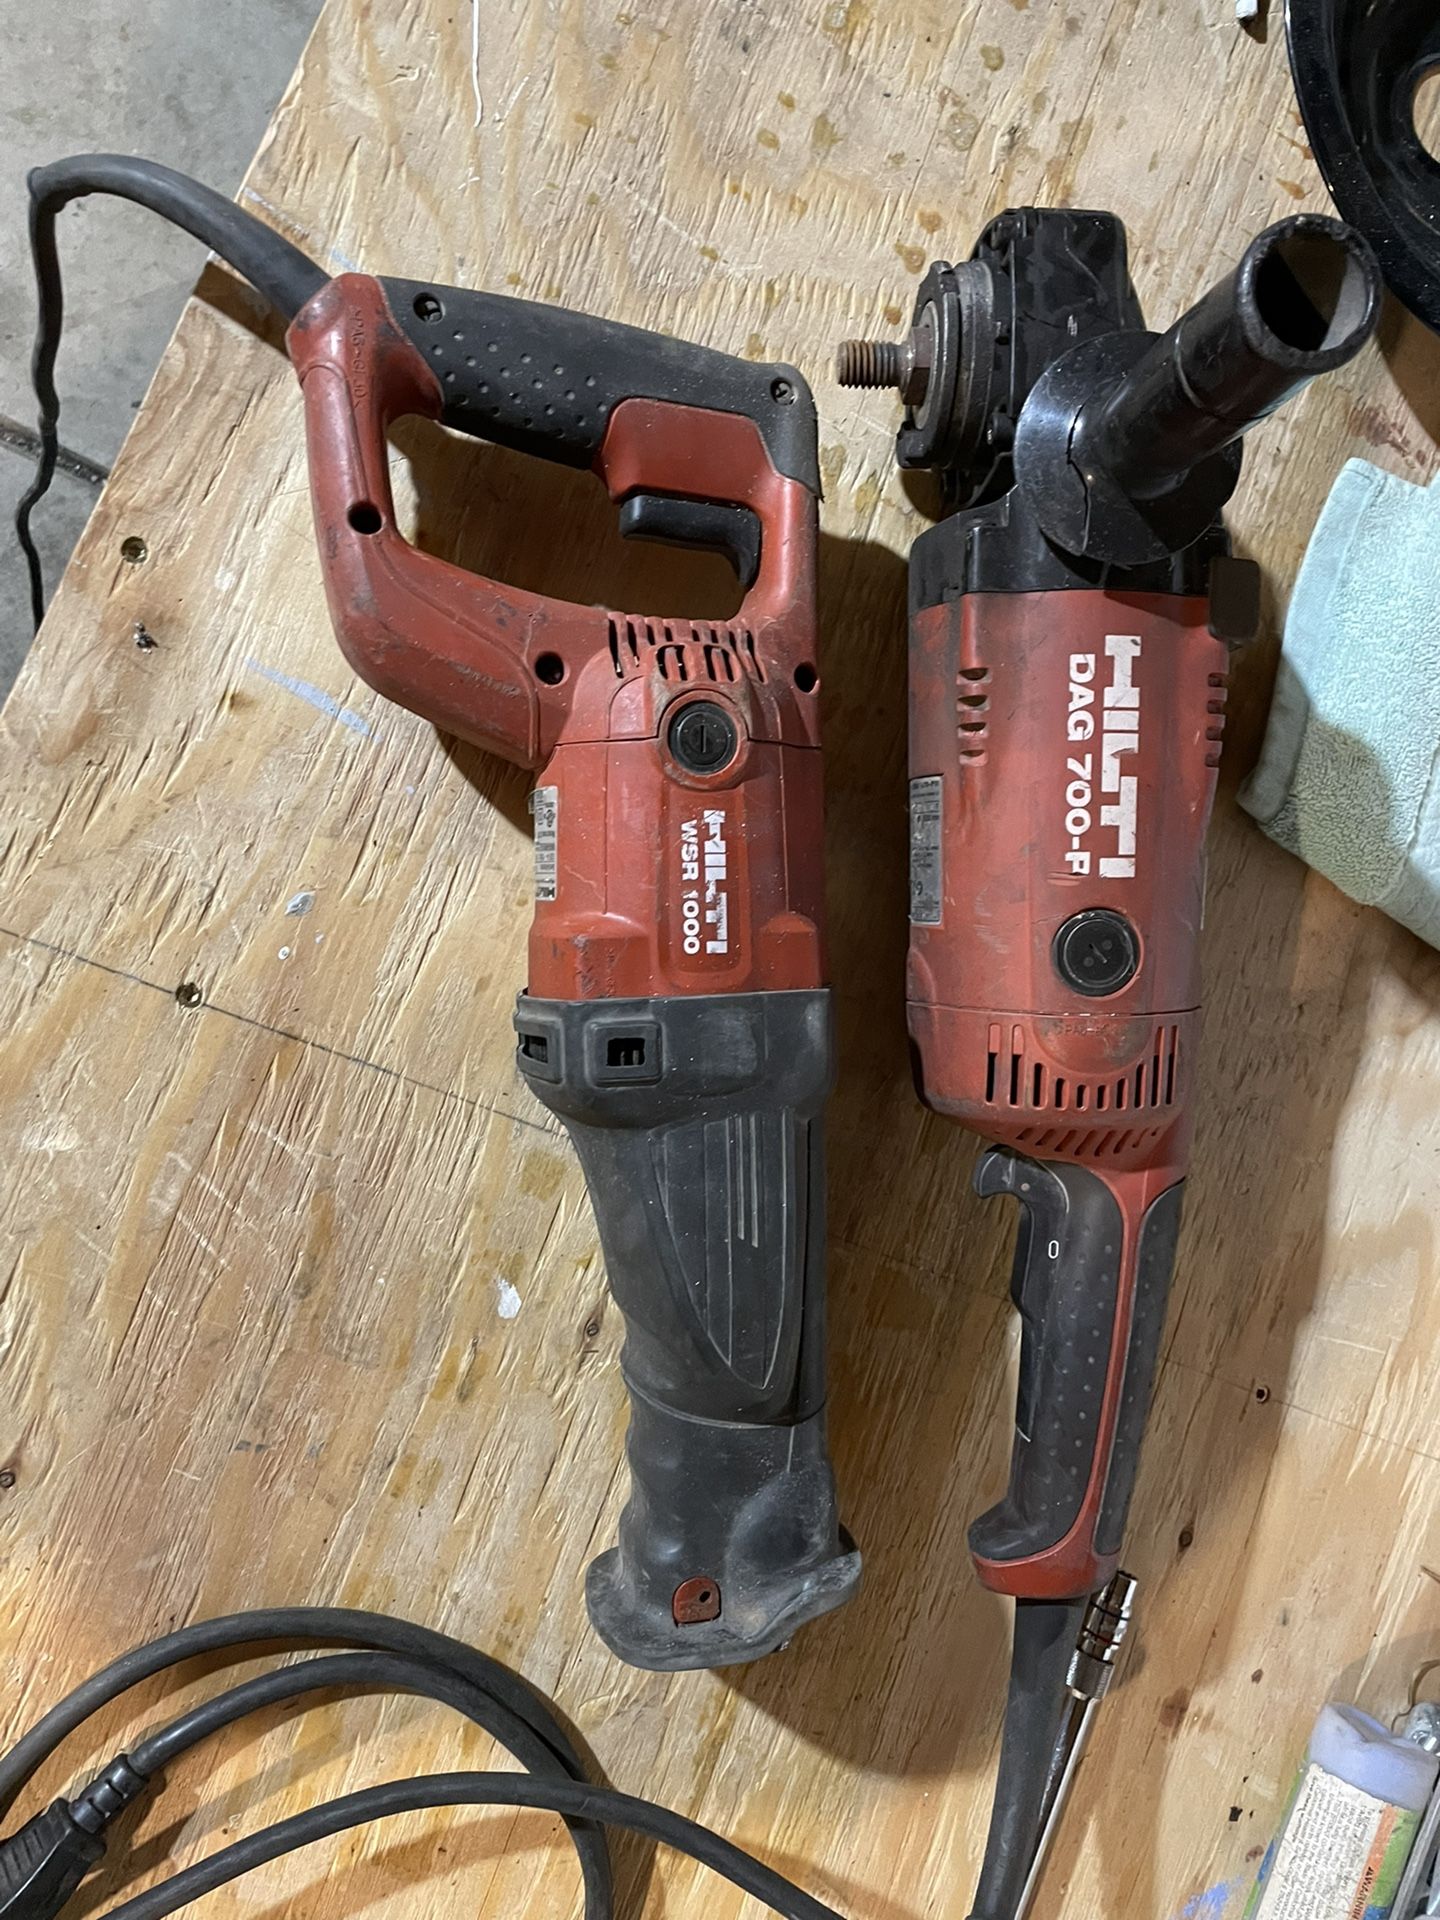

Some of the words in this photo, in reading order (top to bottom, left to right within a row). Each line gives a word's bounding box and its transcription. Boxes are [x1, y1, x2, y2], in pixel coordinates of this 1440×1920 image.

[1068, 653, 1095, 741] DAG
[1099, 635, 1141, 878] HILTI
[681, 820, 699, 880] WSR
[704, 810, 728, 954] HILTI
[683, 890, 700, 954] 1000
